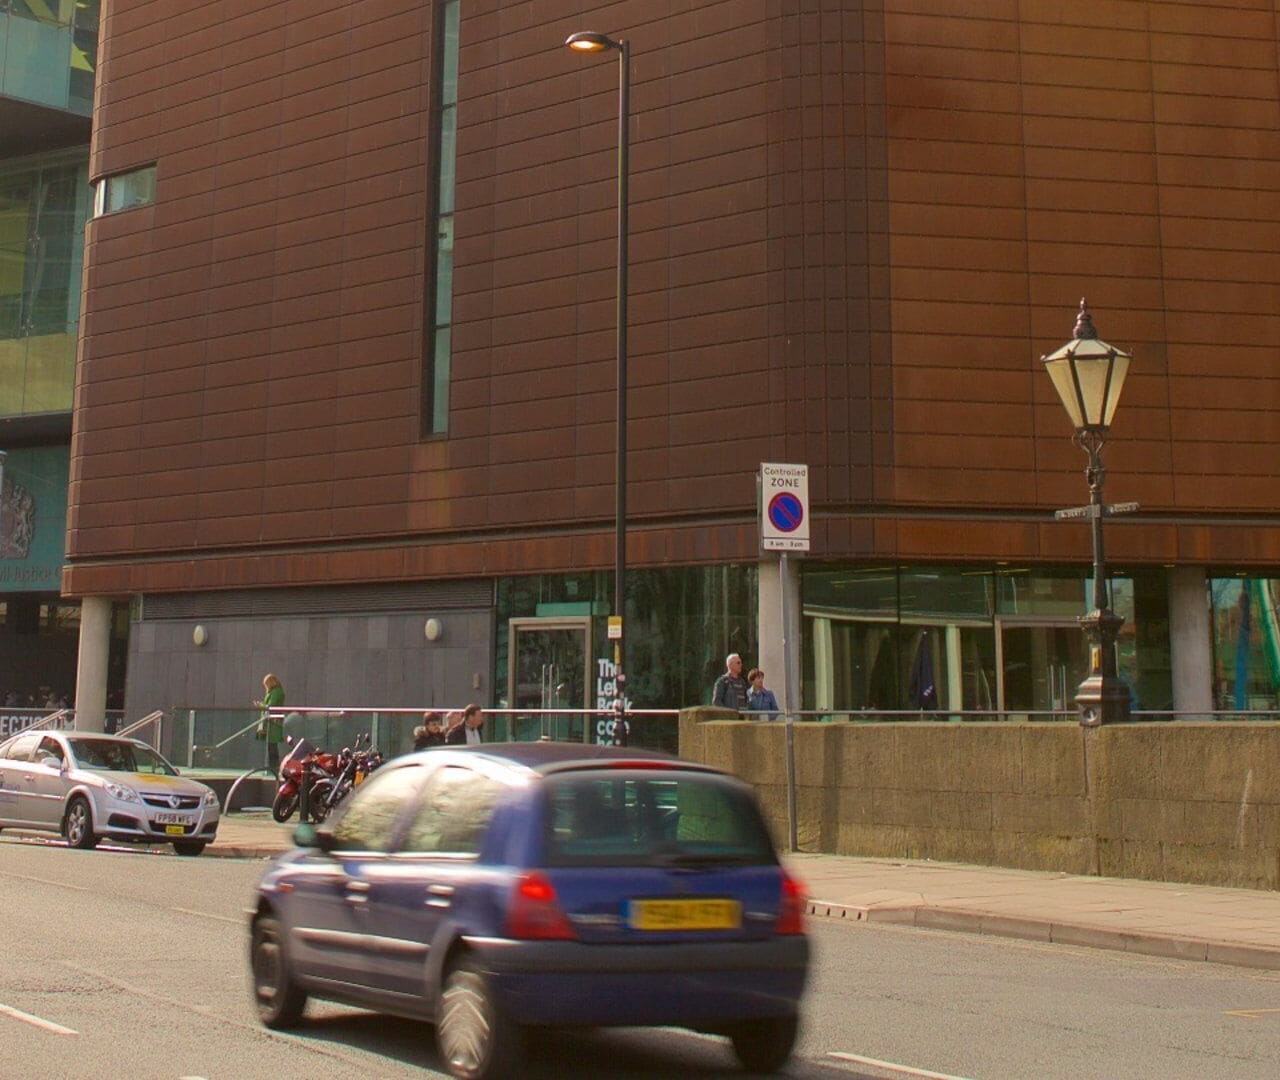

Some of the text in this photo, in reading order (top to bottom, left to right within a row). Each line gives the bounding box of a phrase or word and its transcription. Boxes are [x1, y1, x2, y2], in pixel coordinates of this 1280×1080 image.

[764, 467, 806, 477] Controlled
[771, 478, 800, 487] ZONE
[597, 678, 617, 697] Le
[597, 697, 632, 715] Bak
